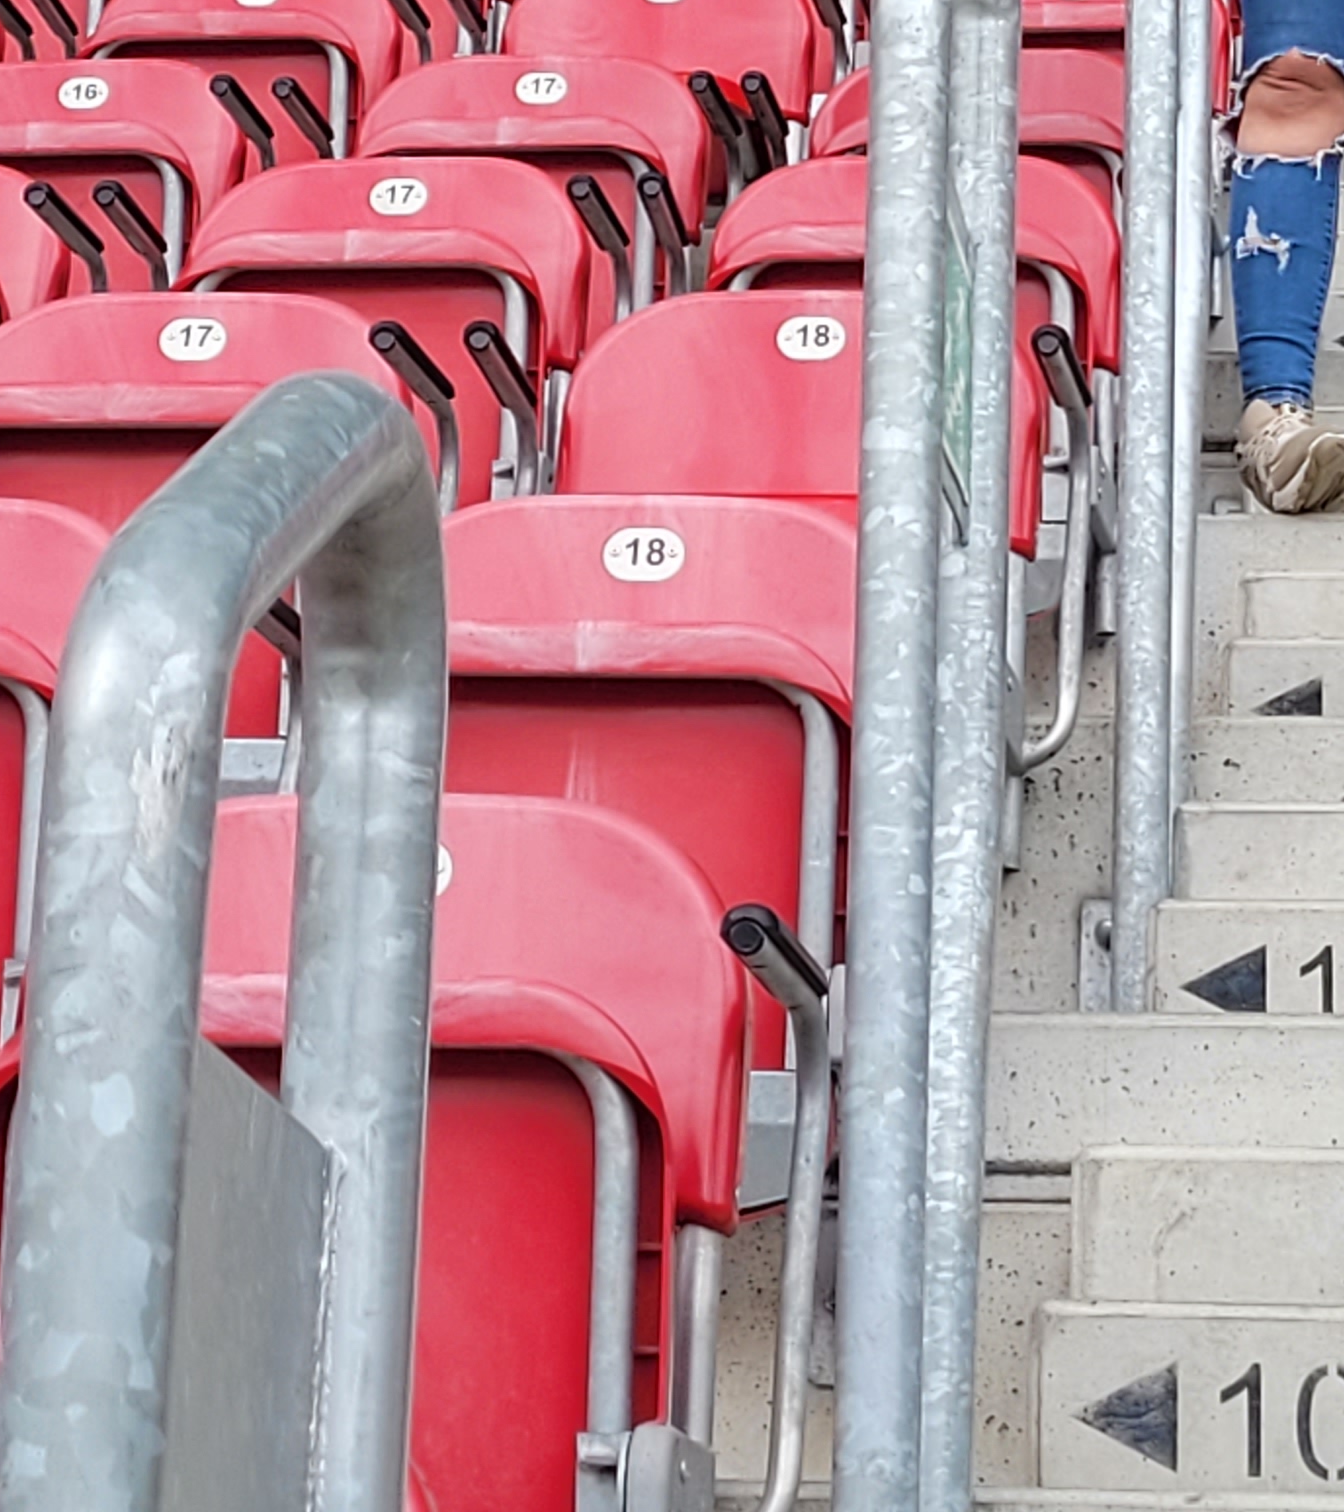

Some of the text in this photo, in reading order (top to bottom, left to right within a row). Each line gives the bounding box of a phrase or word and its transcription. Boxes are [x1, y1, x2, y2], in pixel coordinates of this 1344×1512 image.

[73, 83, 98, 101] 16
[532, 77, 557, 95] 17
[385, 184, 415, 204] 17
[179, 324, 214, 347] 17
[796, 324, 830, 347] 18
[625, 537, 666, 567] 18
